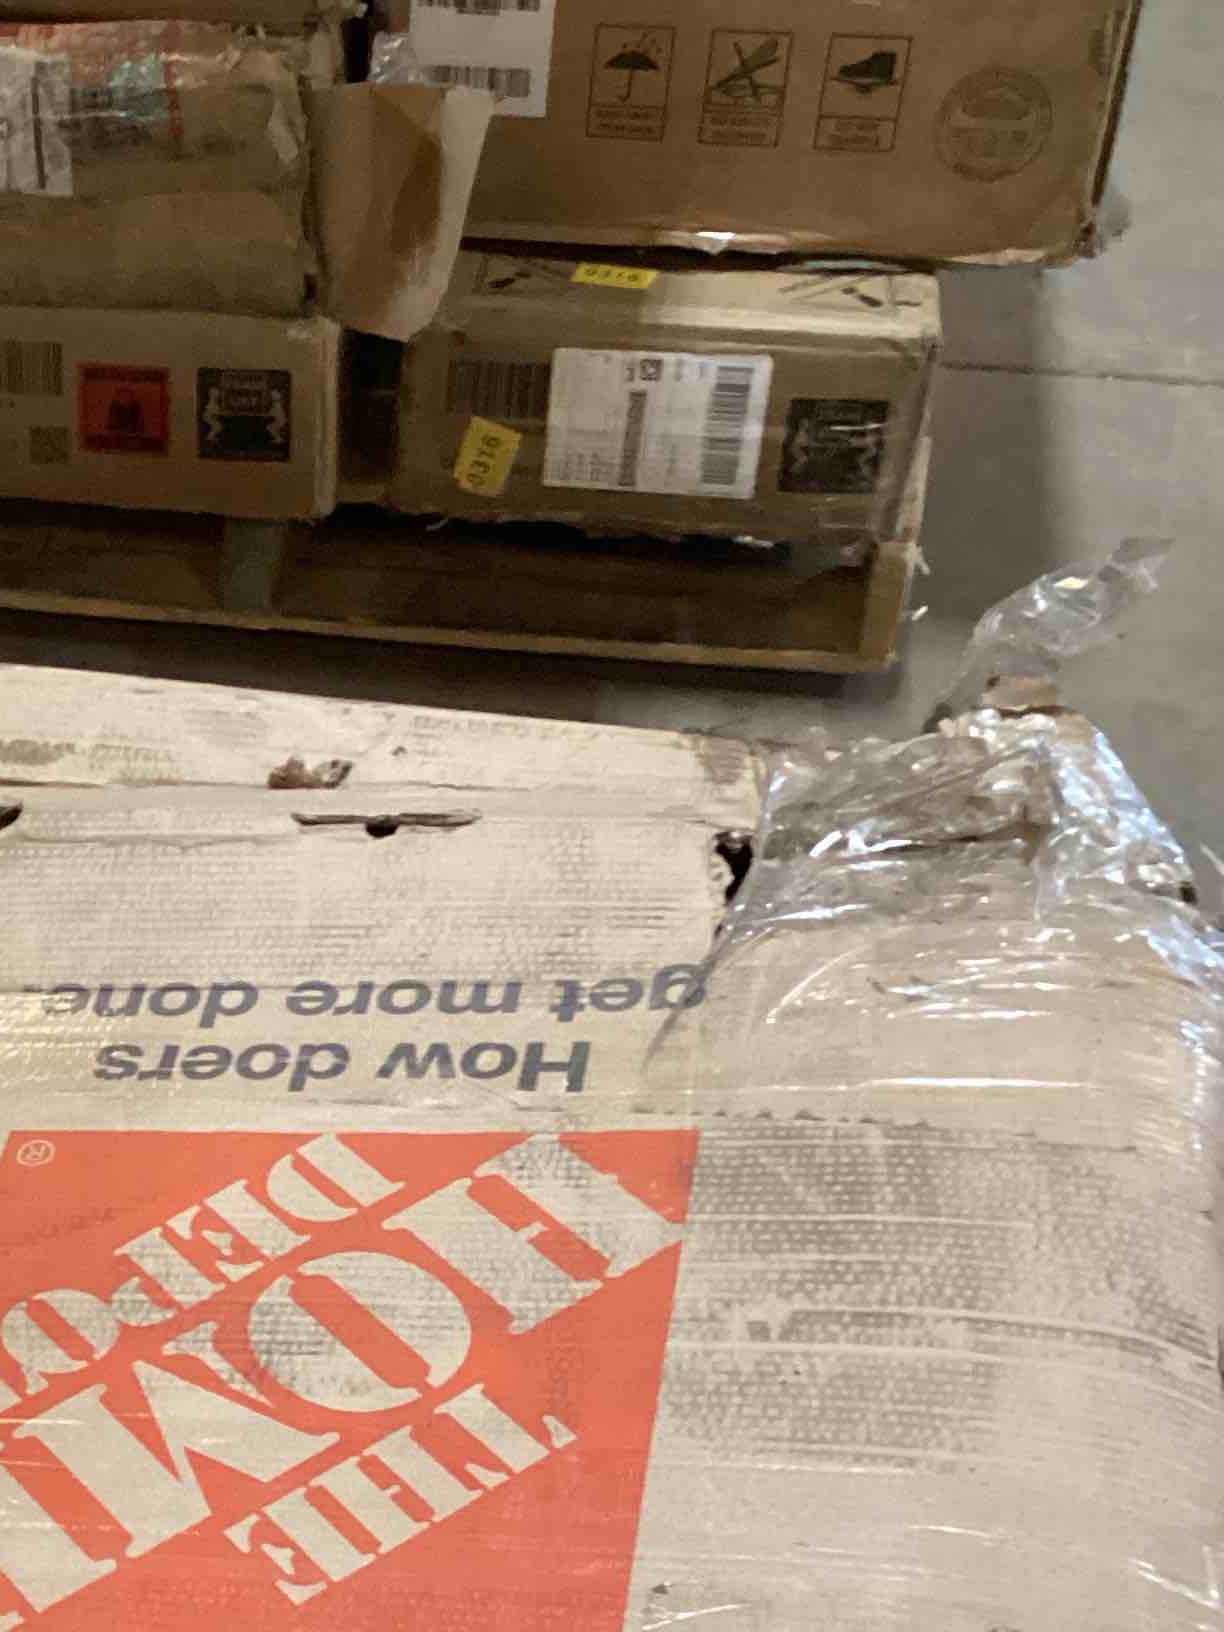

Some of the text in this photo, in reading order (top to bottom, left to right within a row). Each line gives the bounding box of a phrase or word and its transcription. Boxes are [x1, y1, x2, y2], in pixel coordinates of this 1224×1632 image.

[286, 978, 519, 1016] more
[550, 964, 706, 1022] get
[94, 1041, 591, 1092] How doers
[224, 1383, 577, 1605] THE
